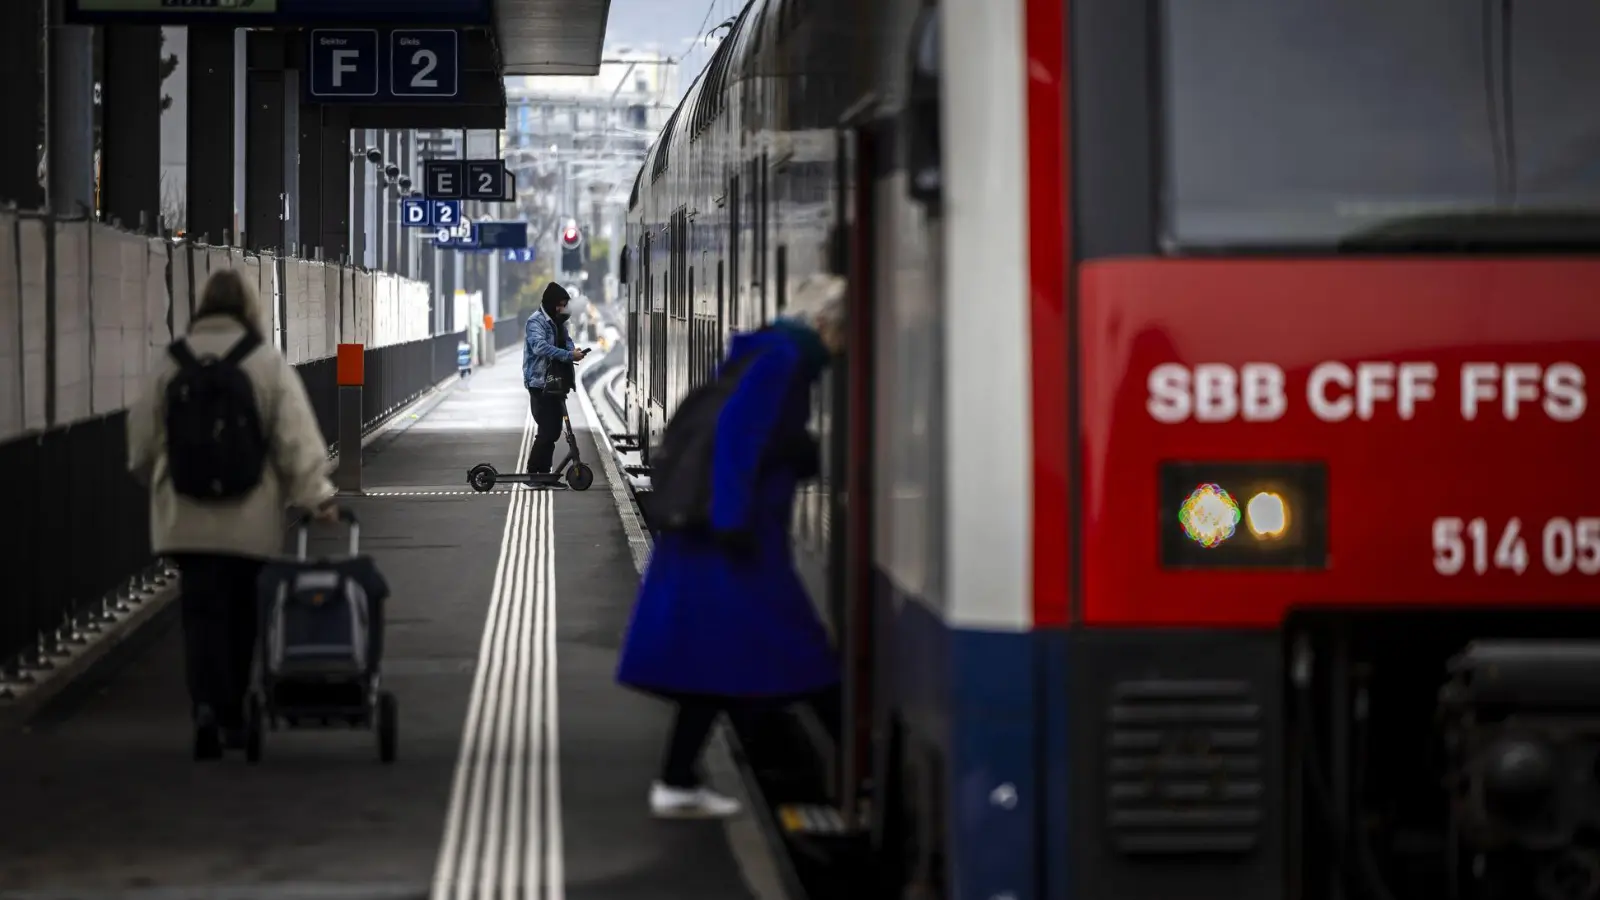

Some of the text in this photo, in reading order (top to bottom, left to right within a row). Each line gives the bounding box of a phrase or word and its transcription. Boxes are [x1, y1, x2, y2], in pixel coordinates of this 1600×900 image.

[320, 37, 348, 46] Sektor
[332, 49, 360, 87] F
[410, 49, 438, 88] 2
[437, 173, 453, 193] E
[478, 172, 493, 193] 2
[409, 206, 424, 222] D
[440, 205, 452, 223] 2
[1146, 360, 1588, 424] SBB CFF FFS
[1431, 516, 1600, 576] 514 05
